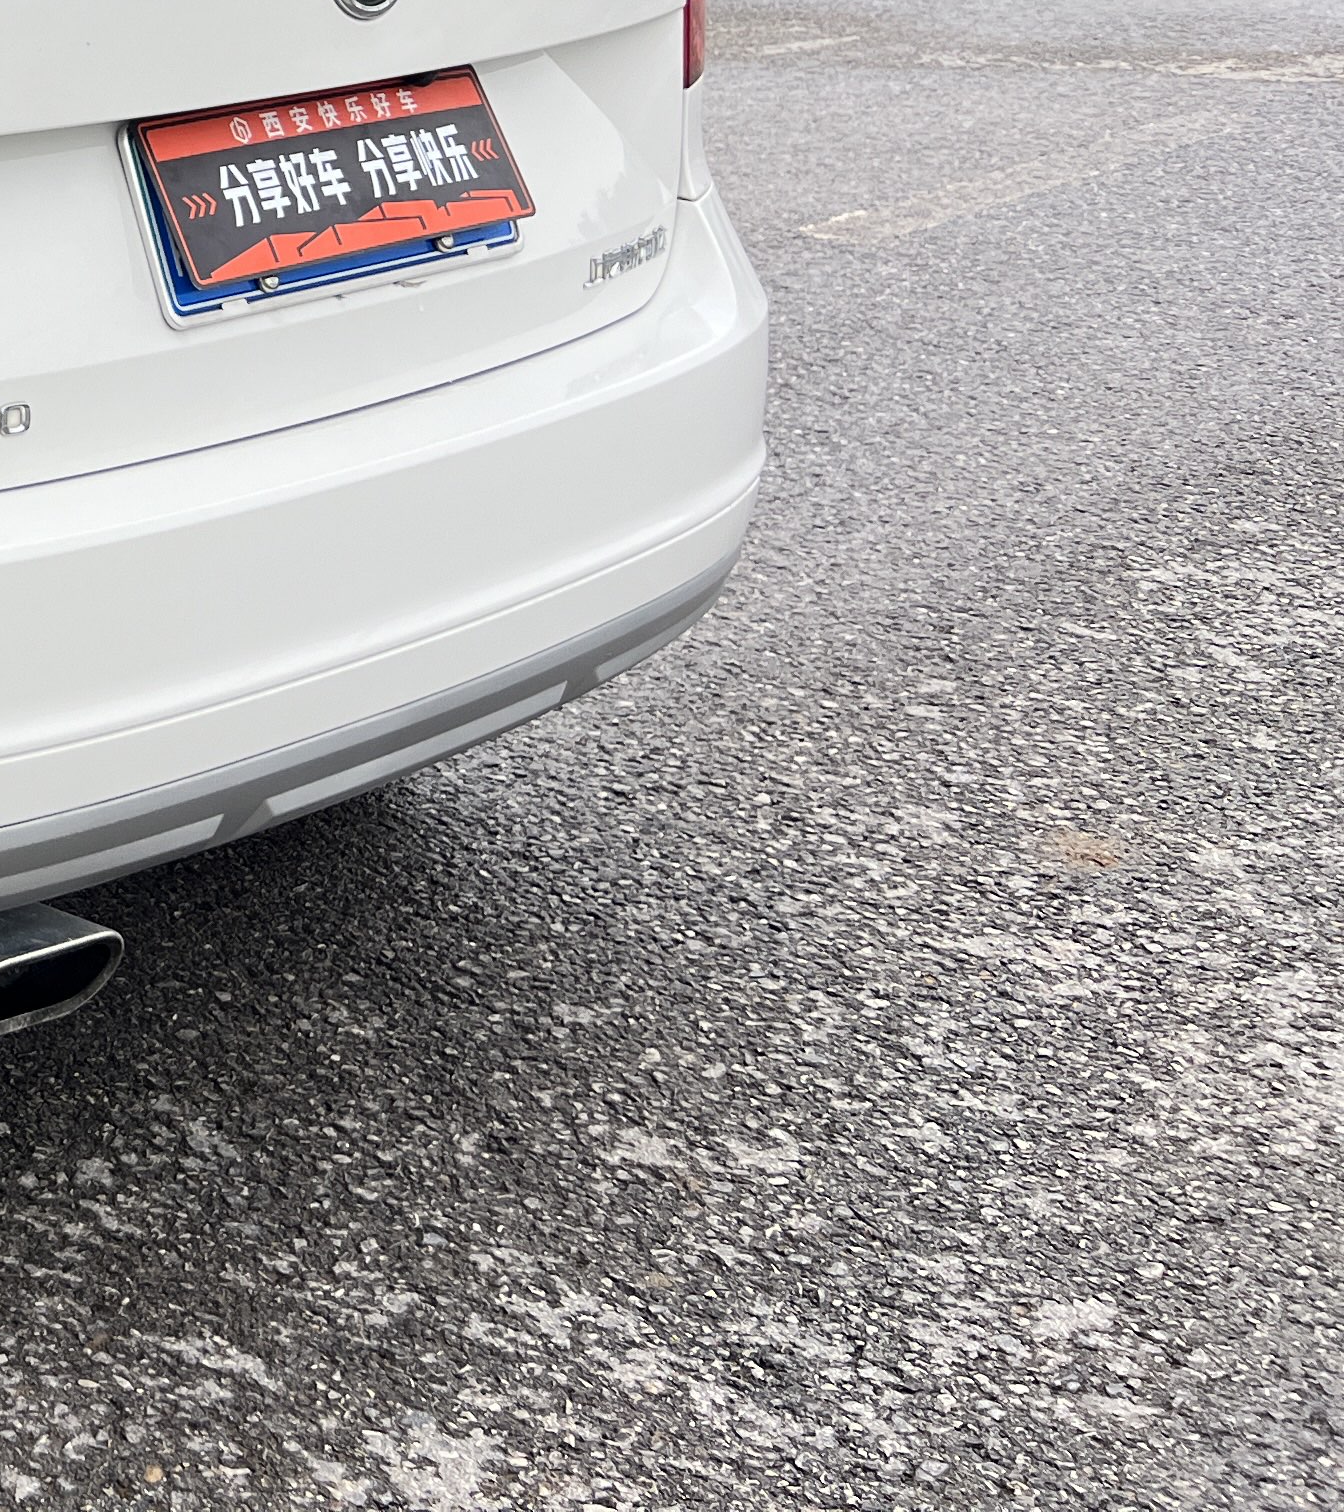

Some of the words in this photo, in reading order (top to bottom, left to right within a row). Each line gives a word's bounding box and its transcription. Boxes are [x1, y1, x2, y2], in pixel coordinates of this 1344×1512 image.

[259, 88, 418, 139] 西安快乐好车
[219, 147, 352, 228] 分享好车
[357, 123, 480, 199] 分享快乐
